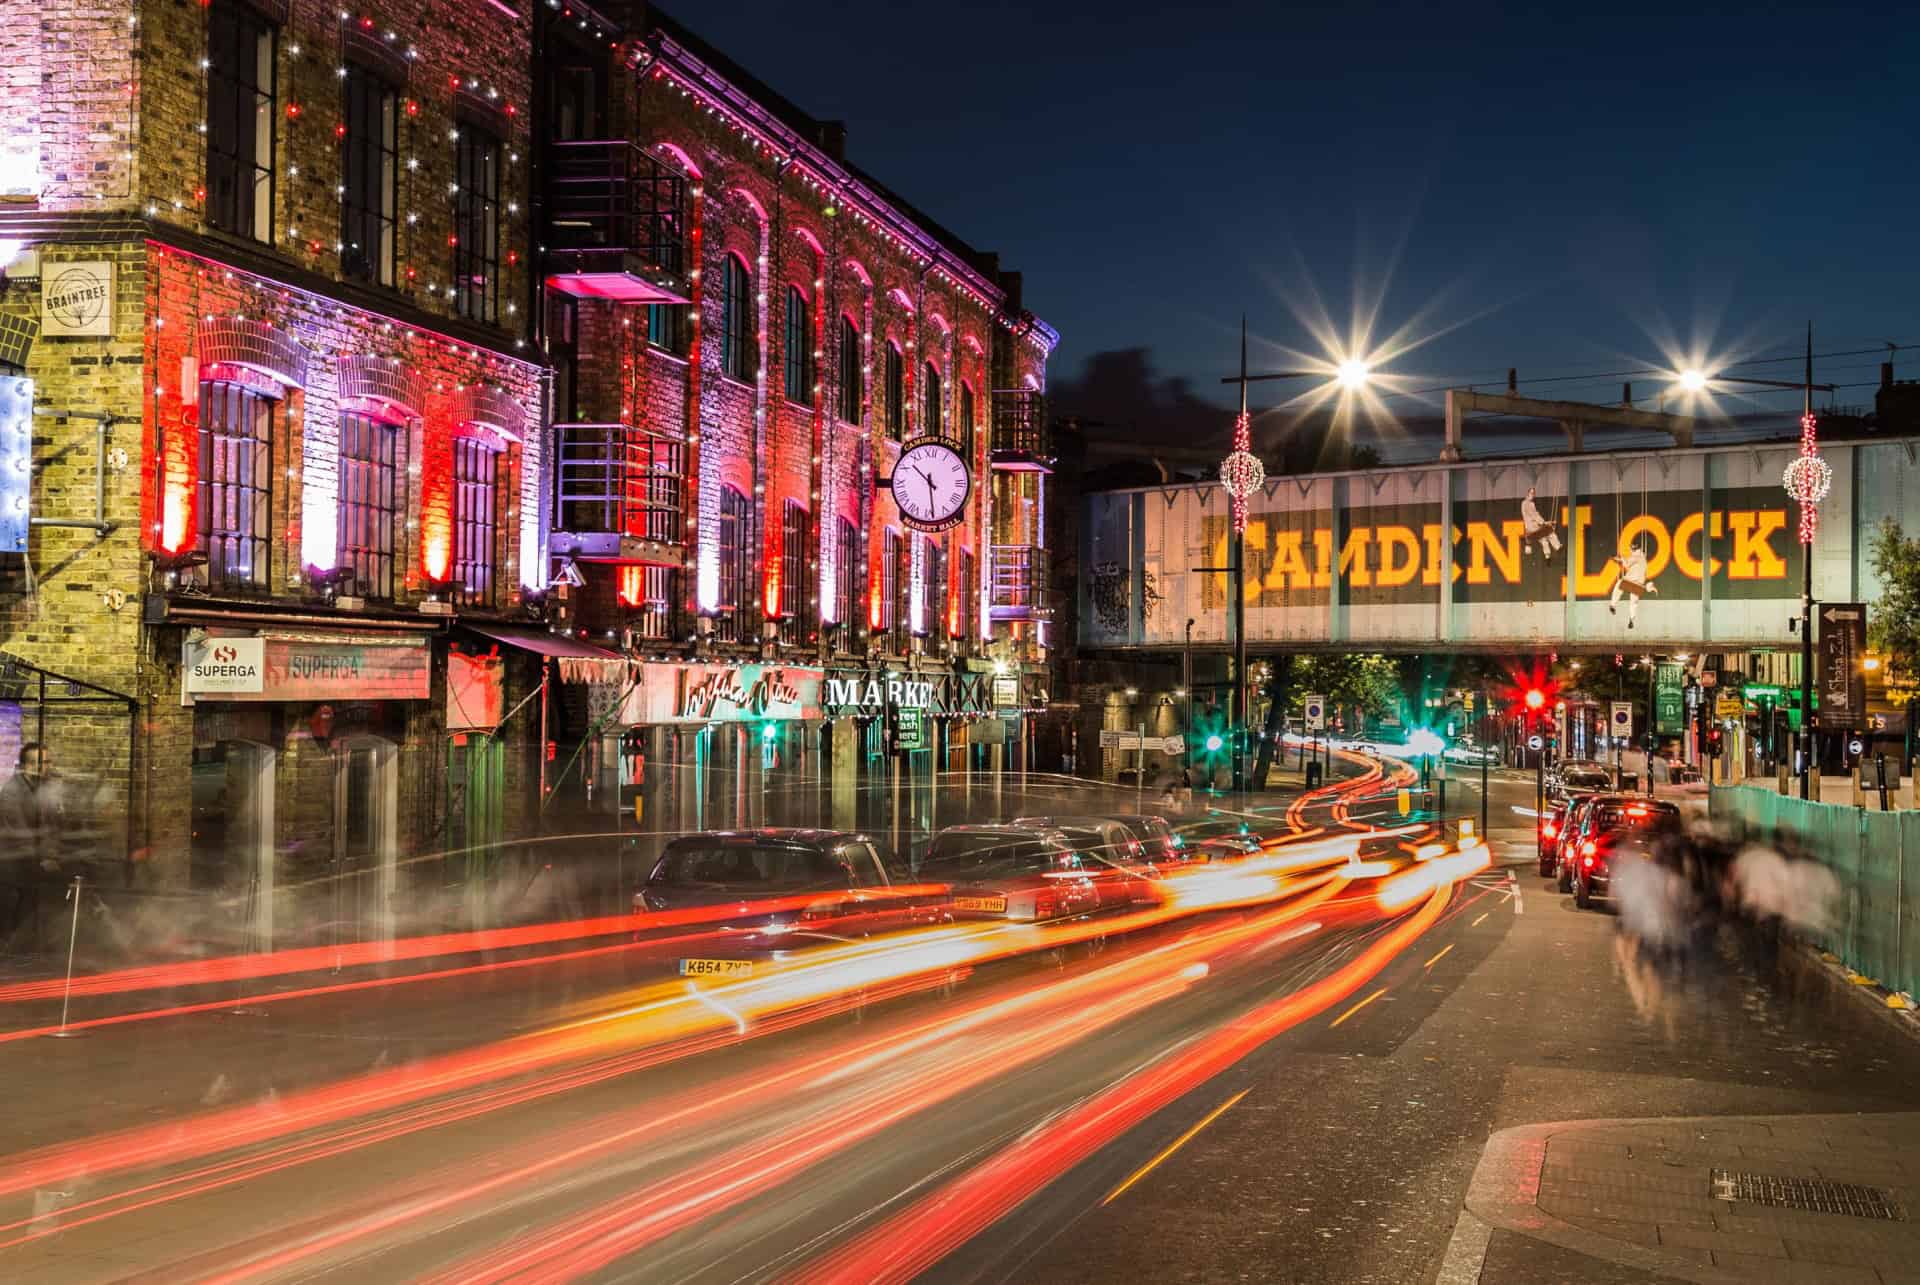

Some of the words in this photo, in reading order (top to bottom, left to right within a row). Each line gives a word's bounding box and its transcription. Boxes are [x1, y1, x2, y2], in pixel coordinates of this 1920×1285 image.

[46, 286, 106, 310] BRAINTREE
[1214, 520, 1525, 602] CAMDEN
[1561, 505, 1787, 597] LOCK
[194, 665, 257, 677] SUPERGA
[292, 655, 360, 680] SUPERGA
[899, 712, 917, 721] ree
[899, 720, 918, 730] ash
[687, 961, 721, 973] KB54
